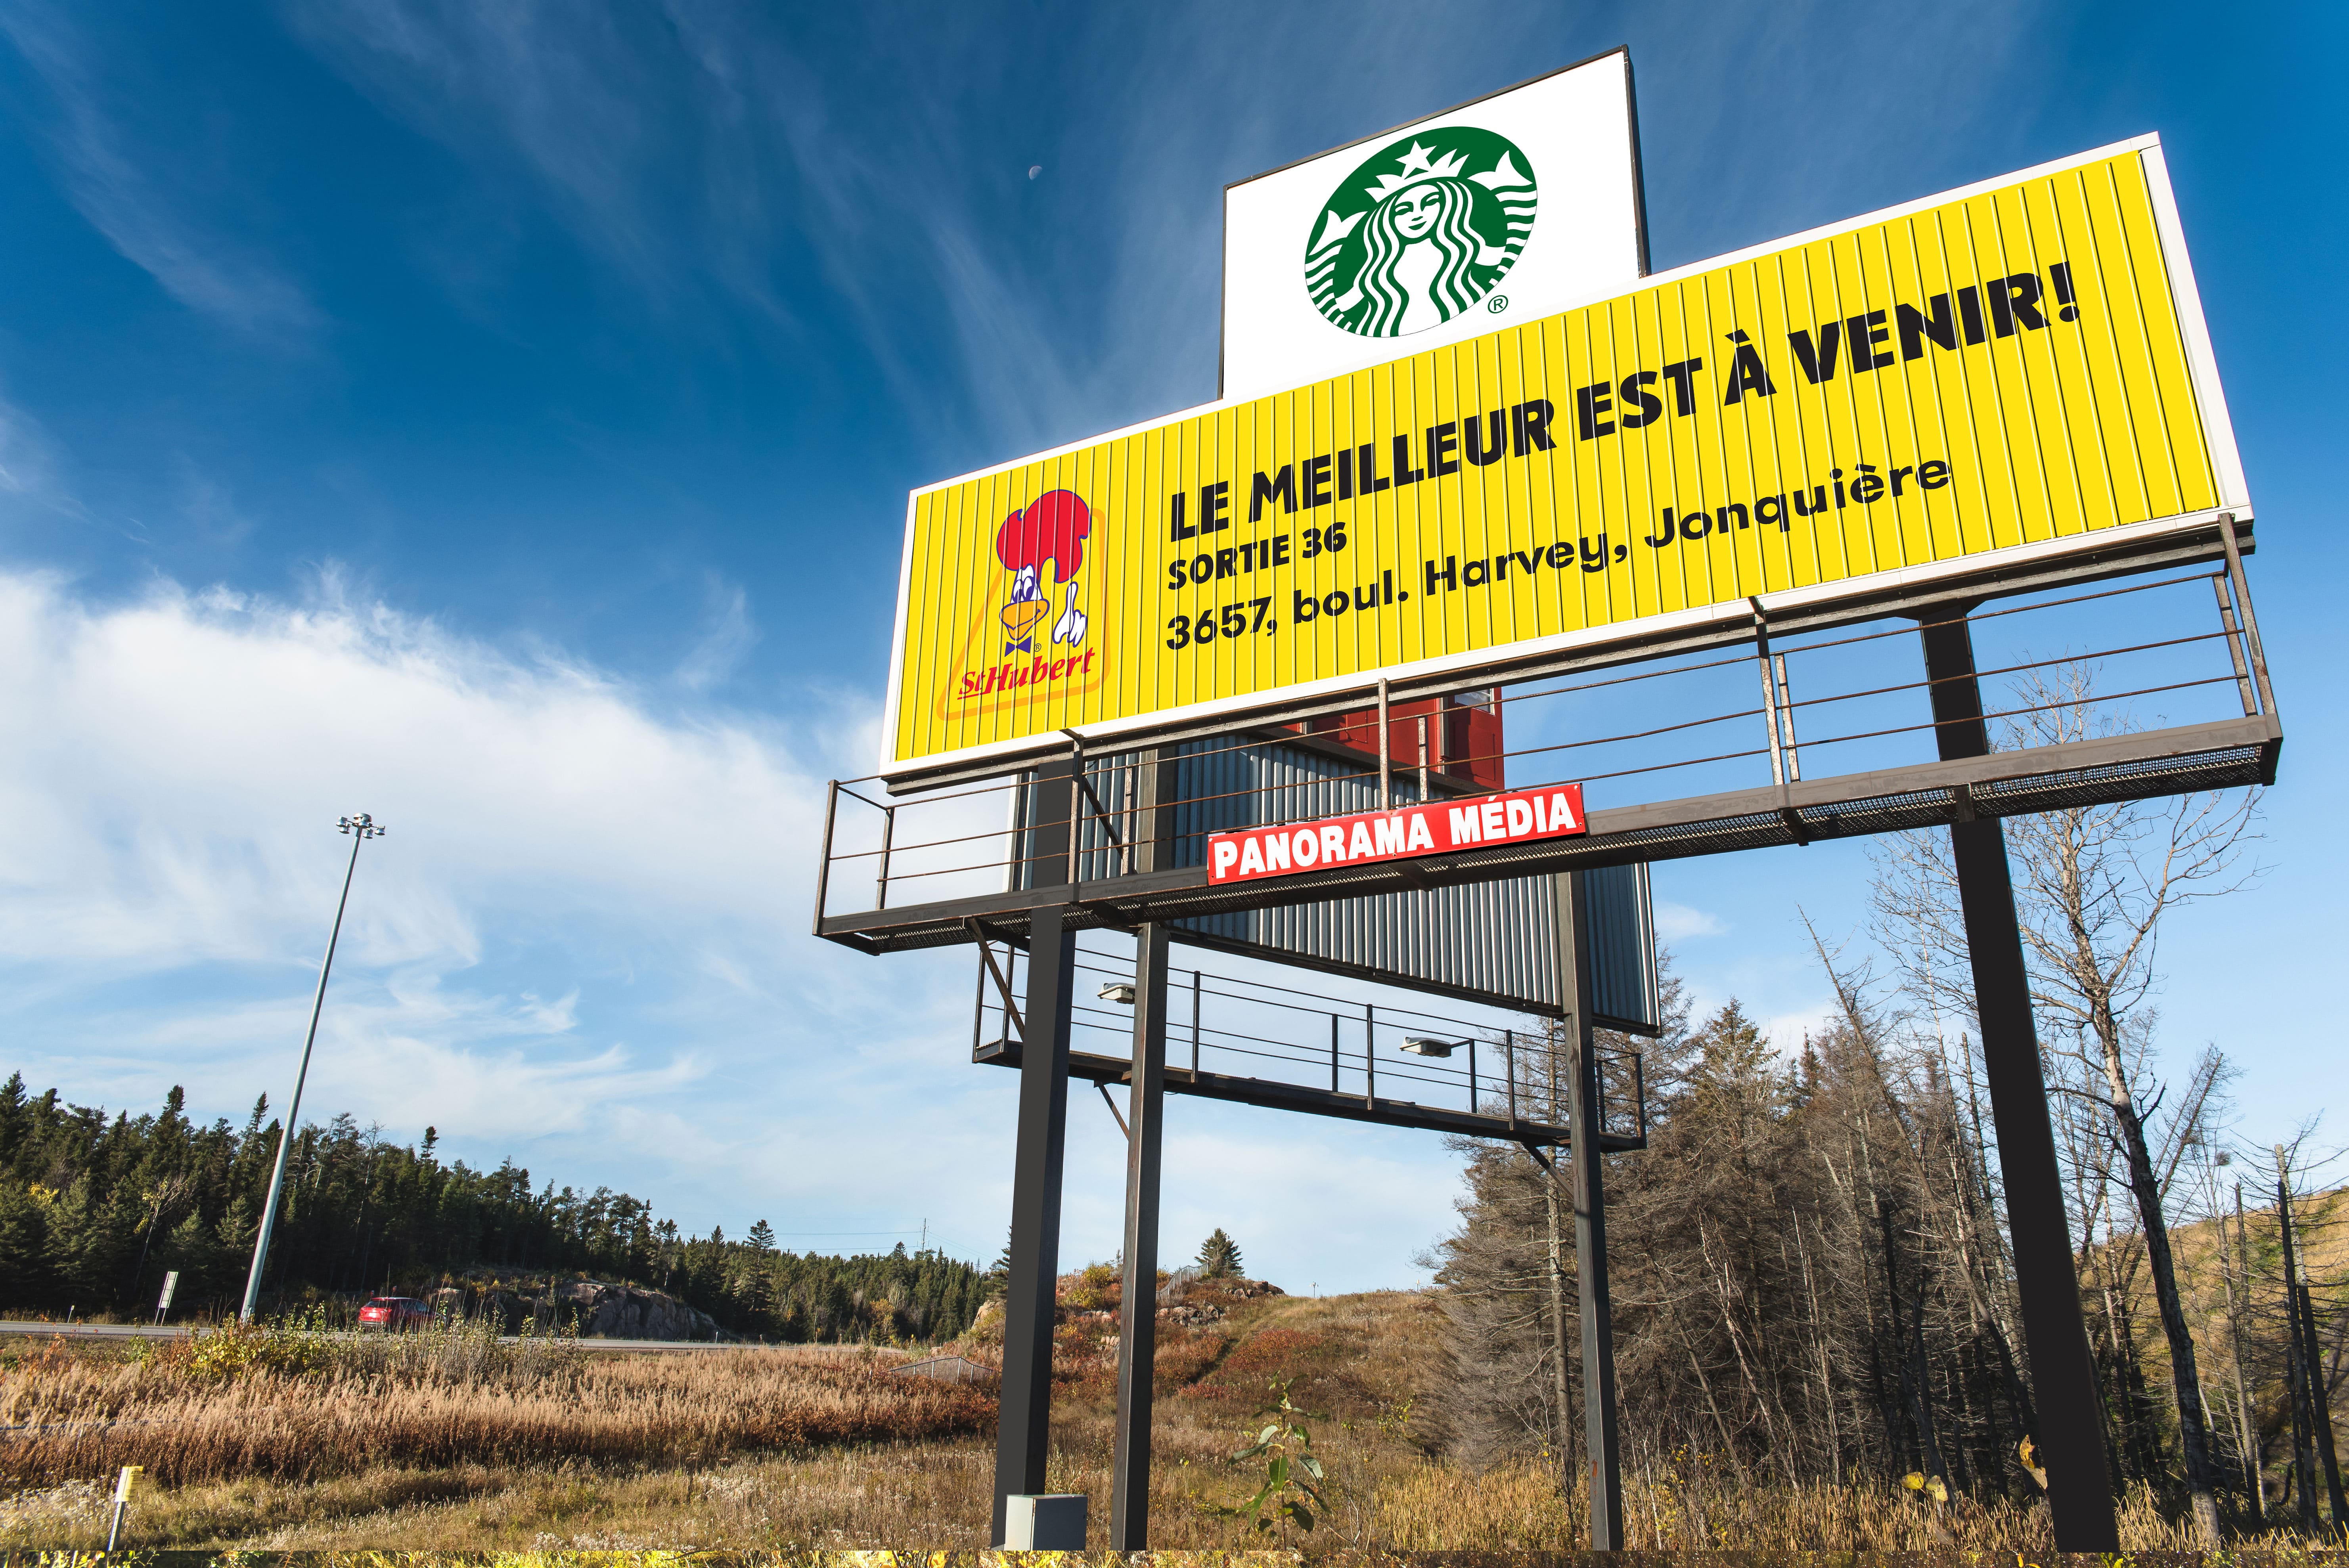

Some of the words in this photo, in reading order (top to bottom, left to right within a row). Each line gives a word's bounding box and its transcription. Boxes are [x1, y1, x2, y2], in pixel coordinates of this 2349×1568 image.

[1170, 481, 1229, 542] LE
[1248, 399, 1556, 523] MEILLEUR
[1576, 357, 1703, 441] EST
[1724, 329, 1776, 406] À
[1788, 261, 2081, 385] VENIR!
[1166, 596, 1277, 650] 3657,
[1293, 569, 1409, 624] boul.
[1425, 533, 1628, 596] Harvey,
[1644, 459, 1953, 548] Jonquière
[1168, 534, 1290, 590] SORTIE
[1302, 521, 1347, 559] 36
[1214, 812, 1435, 879] PANORAMA
[1448, 792, 1577, 846] MÉDIA
